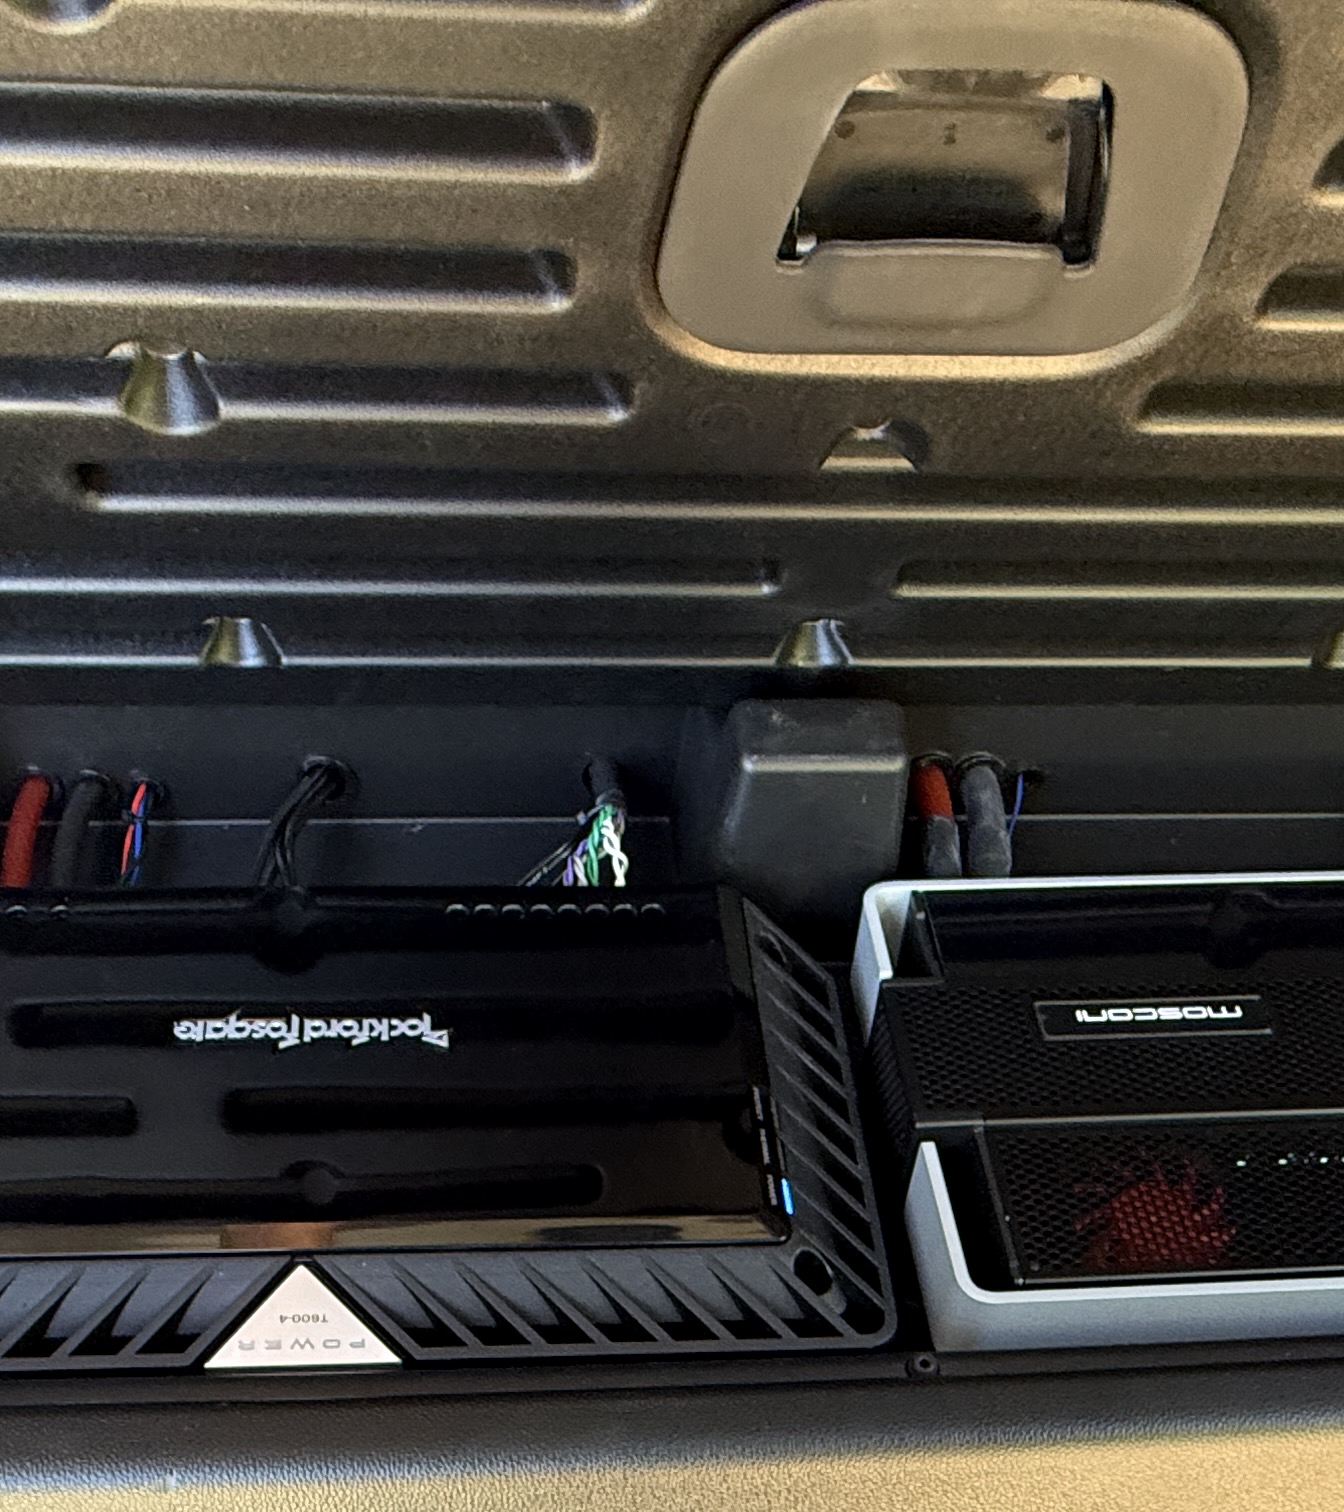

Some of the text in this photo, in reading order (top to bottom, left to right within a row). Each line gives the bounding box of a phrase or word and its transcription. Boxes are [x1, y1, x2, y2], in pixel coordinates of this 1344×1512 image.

[172, 1007, 449, 1050] Rockford Fosgate
[279, 1314, 328, 1324] T600-4
[237, 1337, 366, 1351] POWER
